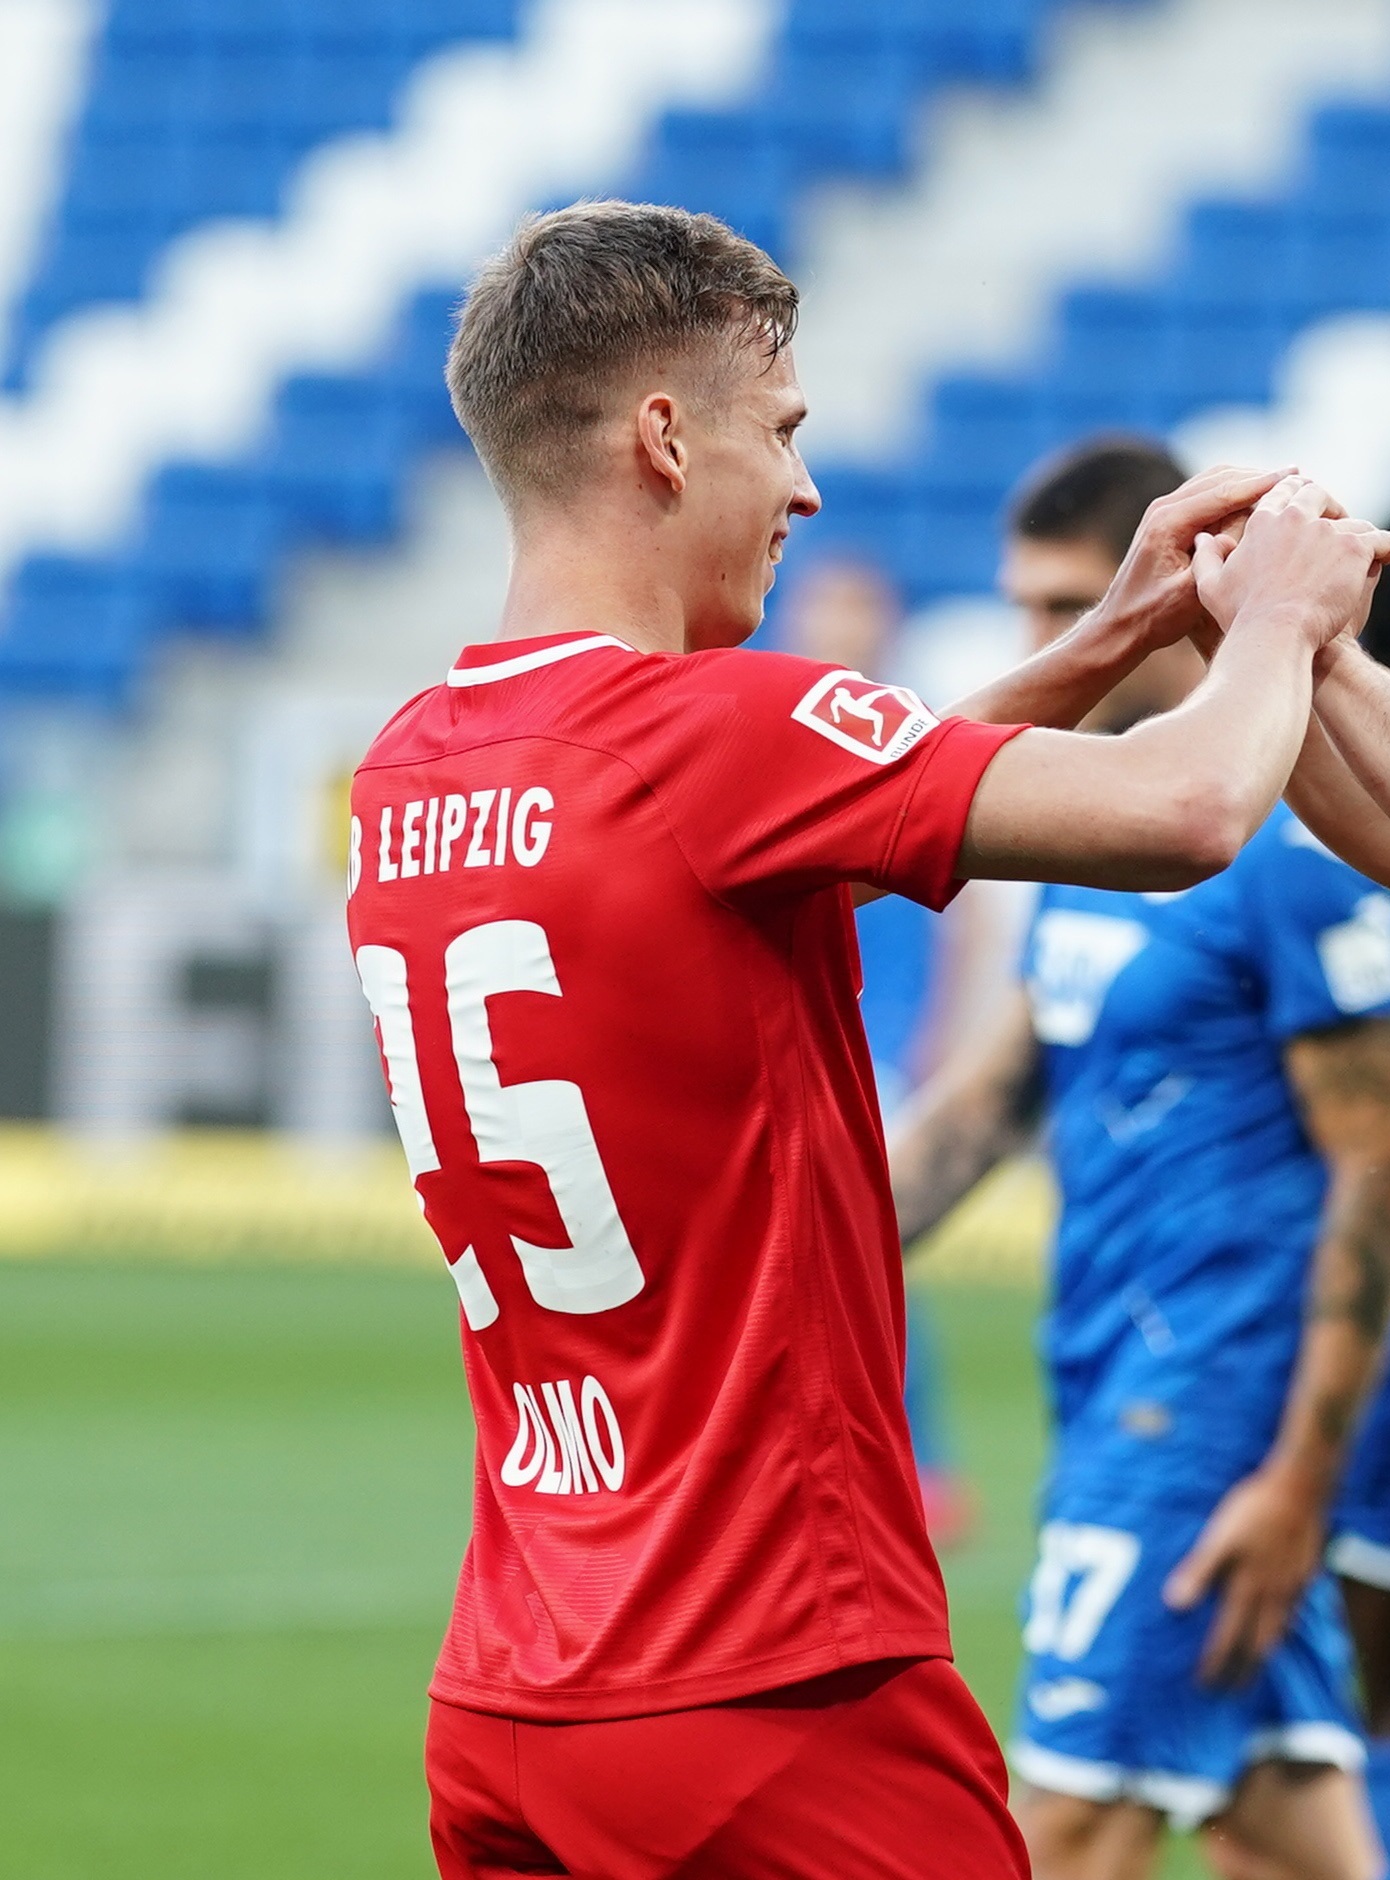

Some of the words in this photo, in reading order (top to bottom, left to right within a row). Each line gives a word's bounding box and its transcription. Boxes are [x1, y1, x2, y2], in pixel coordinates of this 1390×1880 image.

[347, 814, 363, 900] B
[378, 786, 554, 883] LEIPZIG
[356, 919, 645, 1331] 25
[501, 1374, 625, 1495] OLMO
